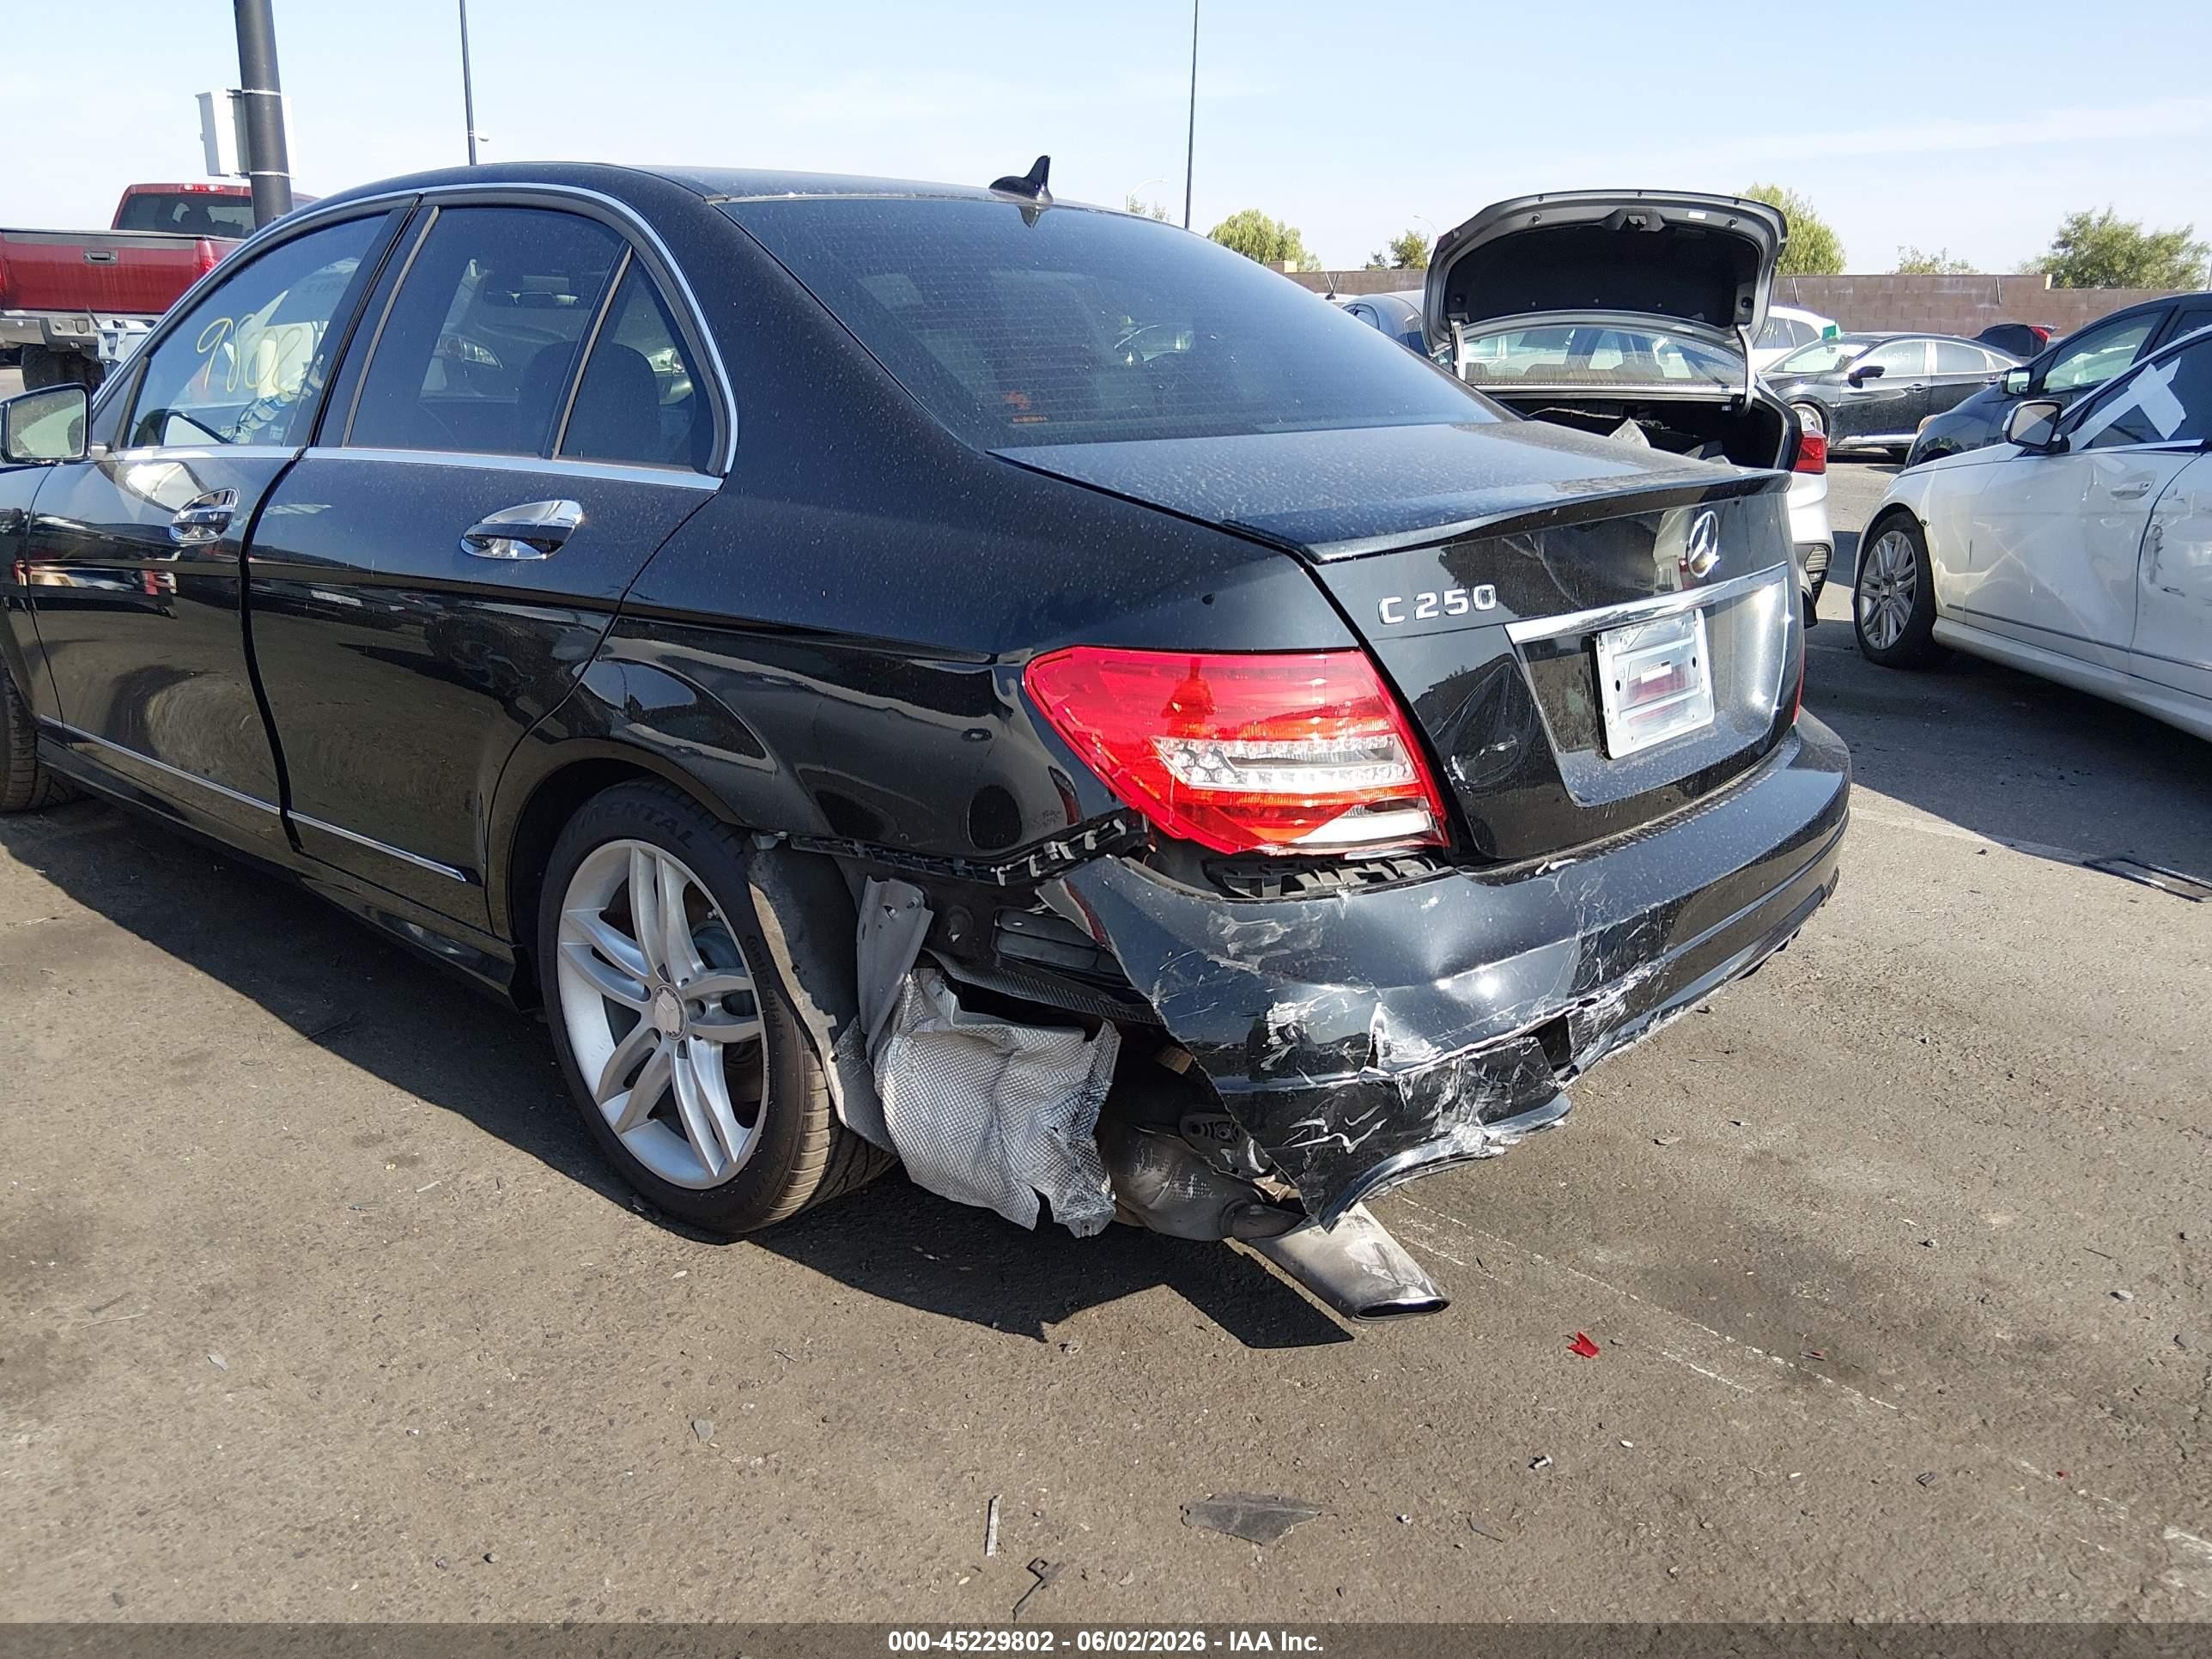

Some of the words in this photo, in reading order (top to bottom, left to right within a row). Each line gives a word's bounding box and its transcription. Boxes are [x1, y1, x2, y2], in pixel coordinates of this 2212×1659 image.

[197, 313, 302, 402] 9802
[1377, 596, 1406, 625] C
[1414, 584, 1497, 621] 250
